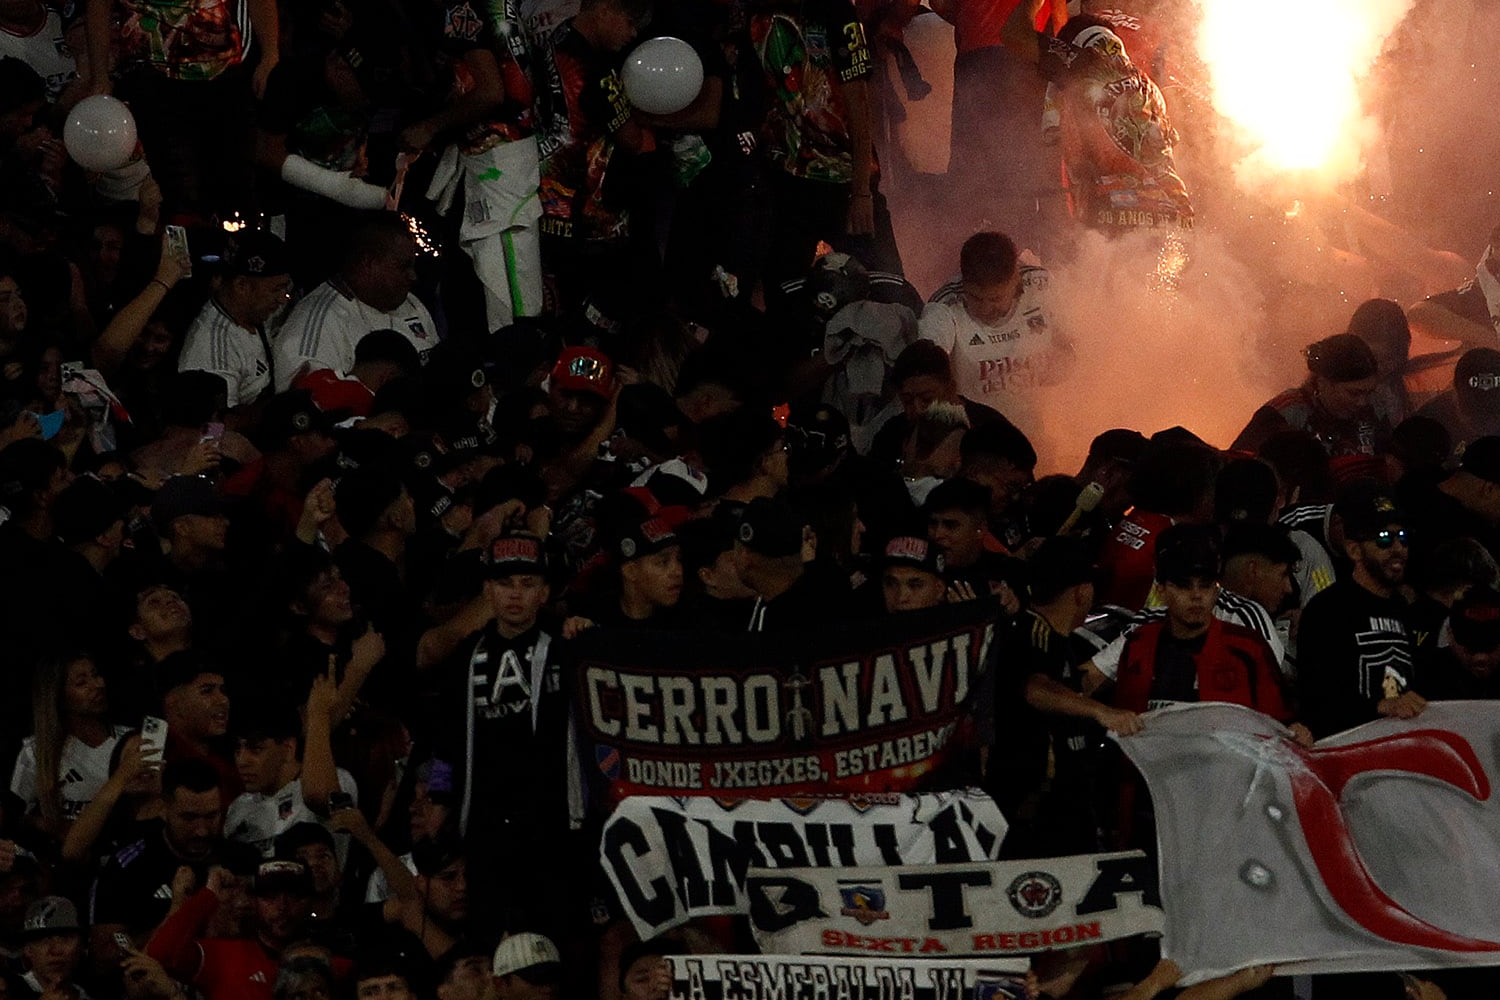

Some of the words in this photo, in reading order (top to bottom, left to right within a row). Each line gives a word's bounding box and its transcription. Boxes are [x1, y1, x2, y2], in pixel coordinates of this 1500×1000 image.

[585, 665, 782, 746] CERRO
[625, 757, 703, 789] DONDE
[709, 754, 829, 789] JXEGXES,
[820, 928, 948, 954] SEXTA
[972, 920, 1102, 953] REGION
[715, 959, 916, 1000] ESMERALDA
